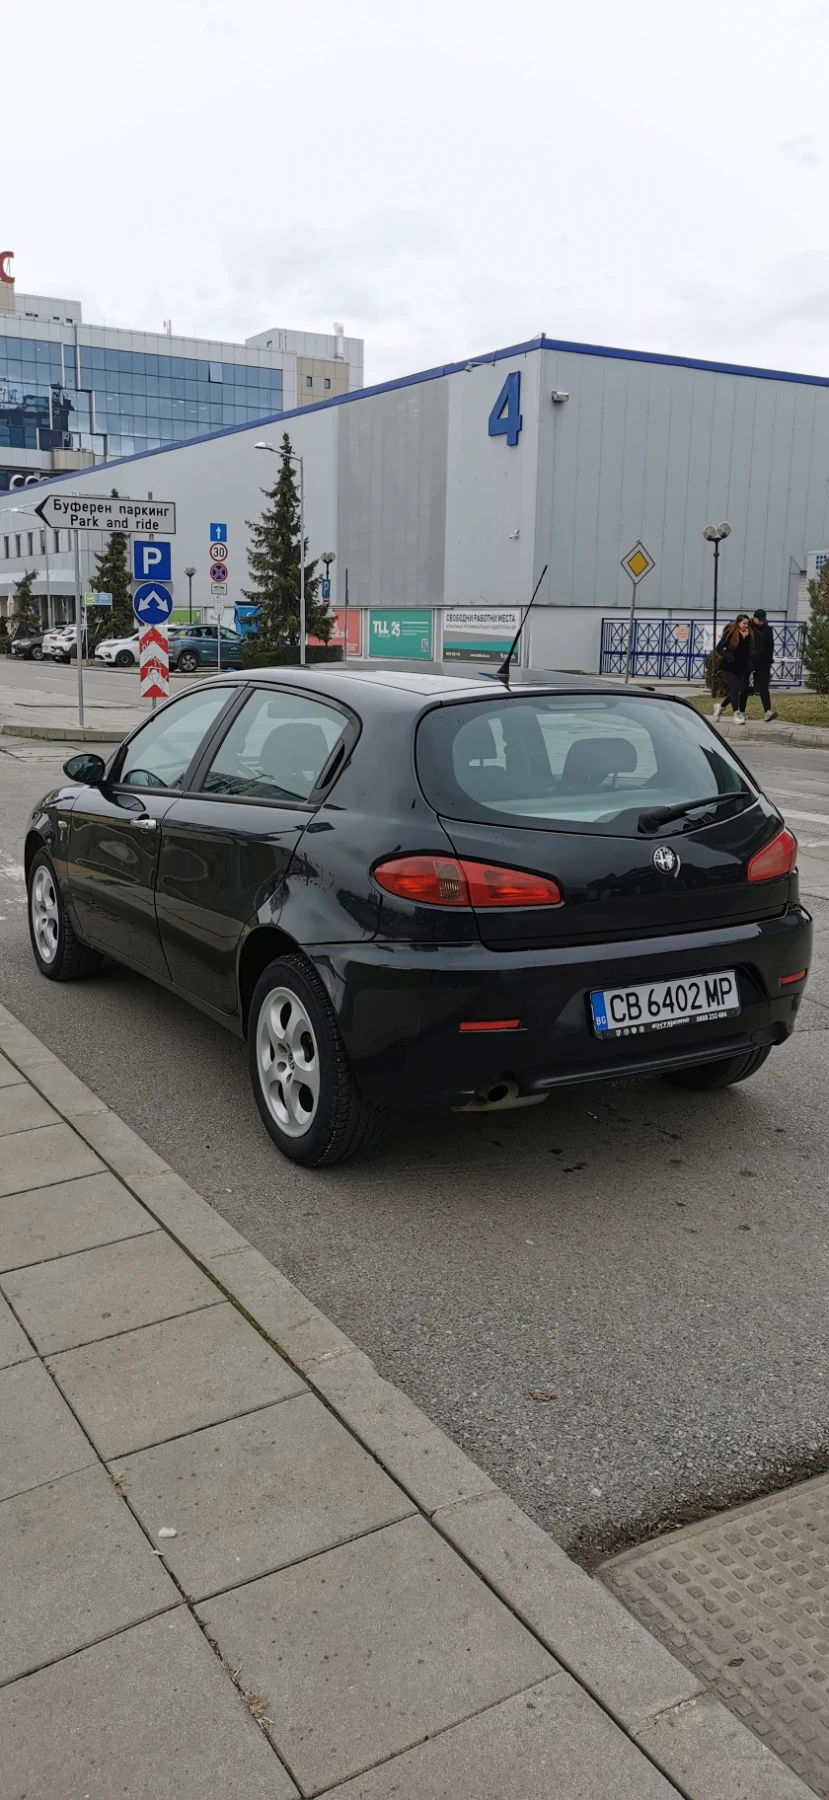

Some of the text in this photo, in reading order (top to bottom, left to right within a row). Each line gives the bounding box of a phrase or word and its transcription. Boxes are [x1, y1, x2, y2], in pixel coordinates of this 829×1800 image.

[488, 370, 523, 447] 4
[53, 498, 169, 517] Буферен паркинг
[70, 514, 159, 530] Park and ride
[142, 546, 162, 575] P
[213, 547, 225, 558] 30
[446, 613, 516, 623] СВОБОДНИ РАБОТНИ МЕСТА
[595, 977, 732, 1026] BG CB 6402 MP
